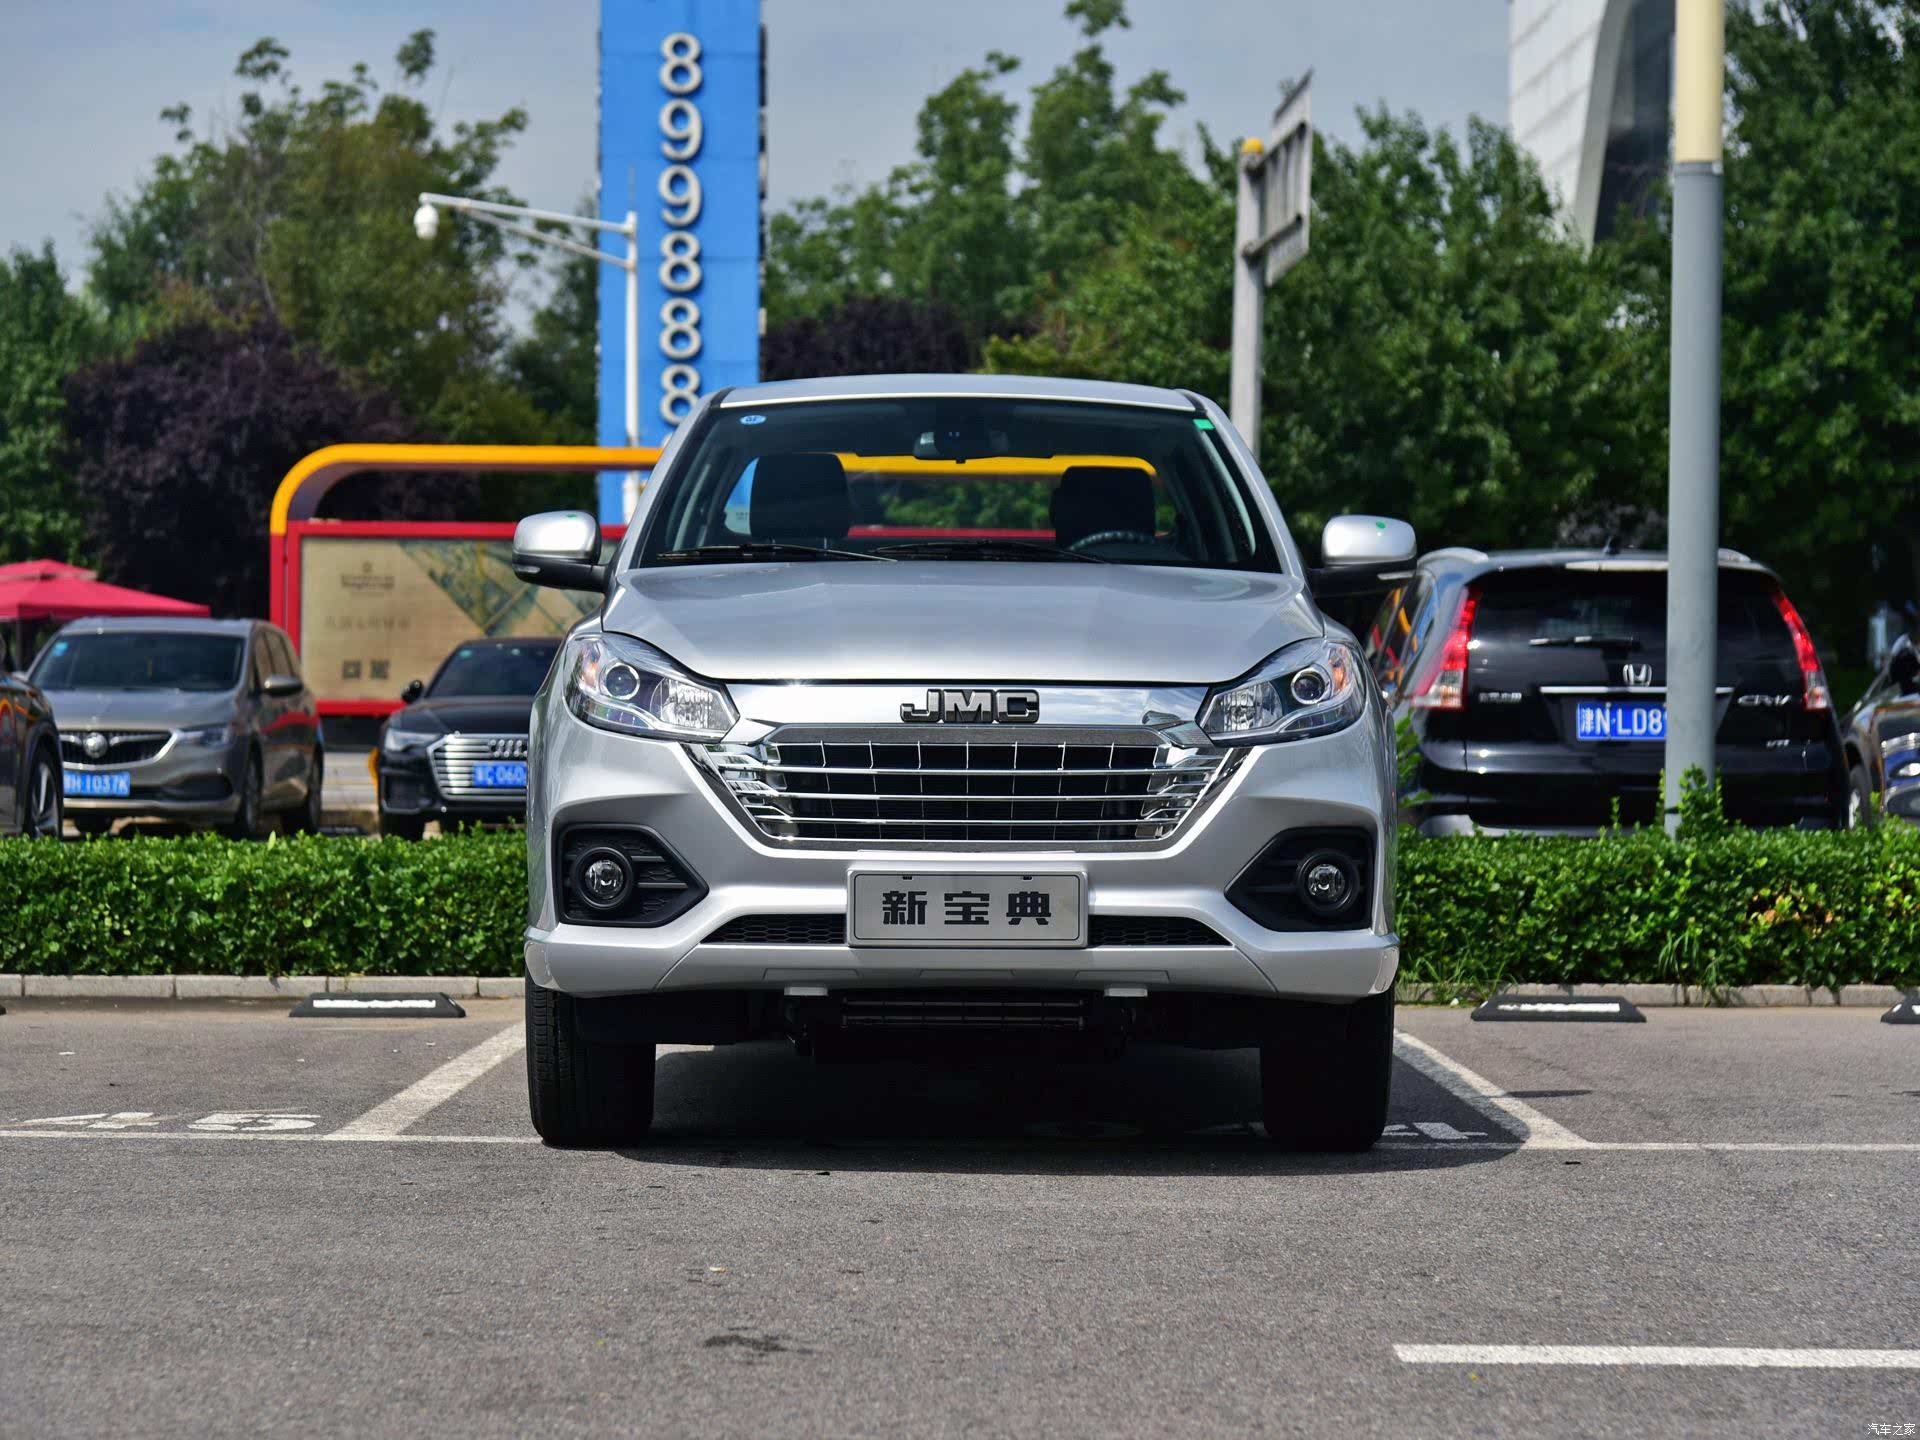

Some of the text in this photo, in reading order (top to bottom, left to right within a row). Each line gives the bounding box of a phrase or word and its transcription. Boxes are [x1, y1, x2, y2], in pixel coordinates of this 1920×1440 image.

[659, 32, 703, 440] 899888
[900, 688, 1040, 724] JMC
[882, 890, 1052, 926] 新宝典
